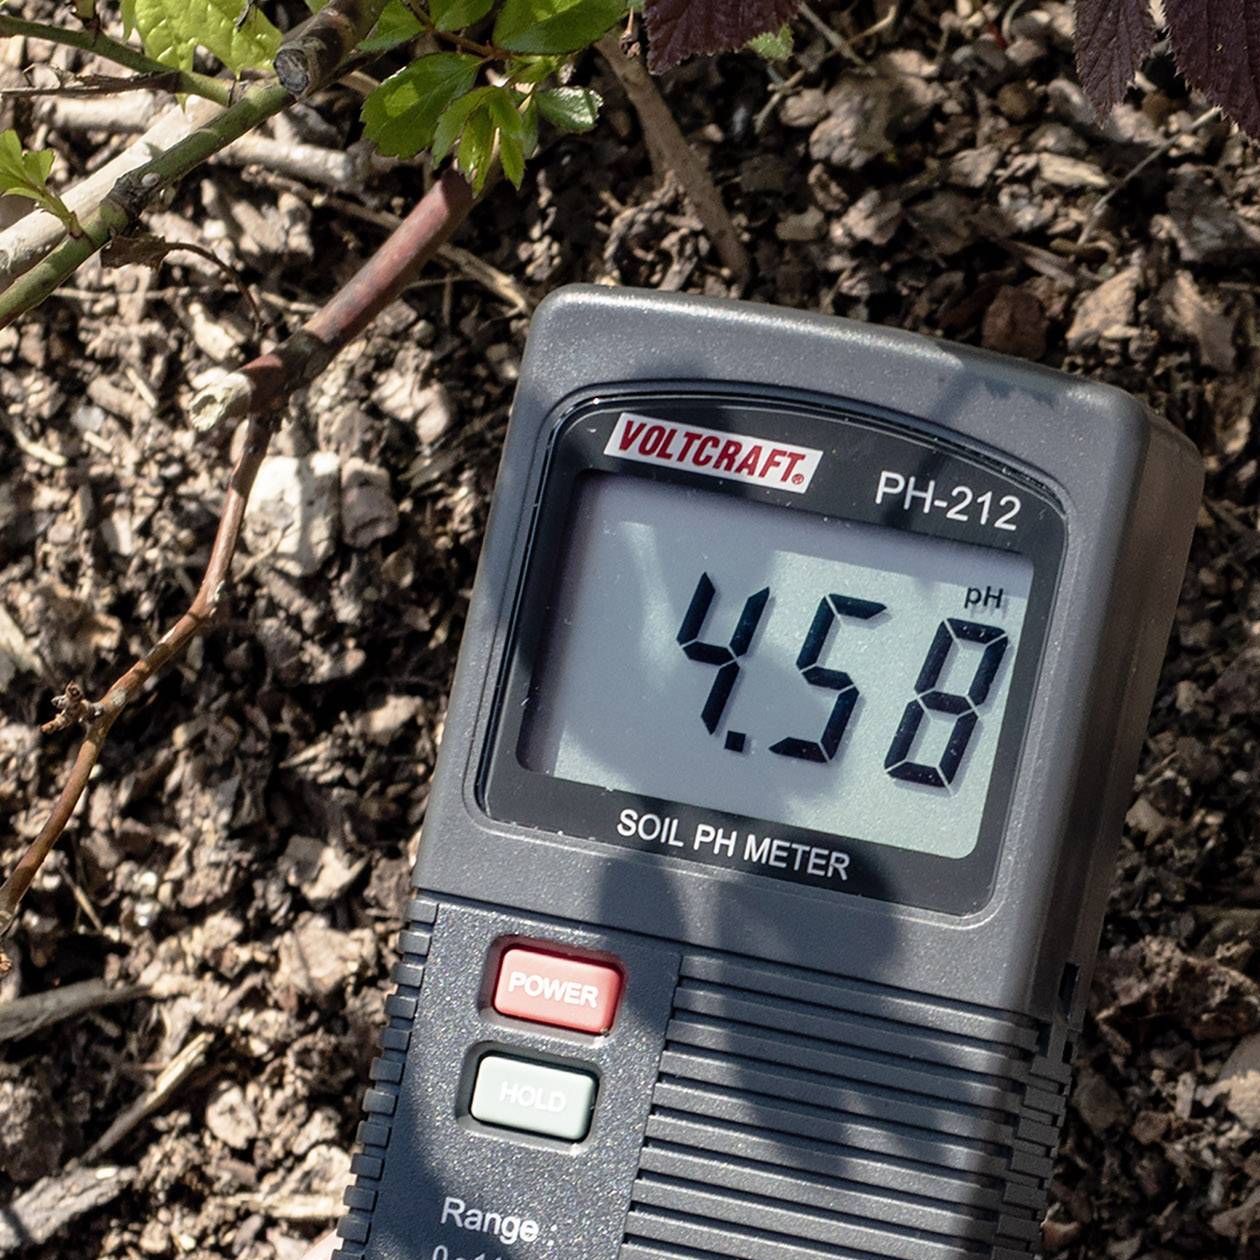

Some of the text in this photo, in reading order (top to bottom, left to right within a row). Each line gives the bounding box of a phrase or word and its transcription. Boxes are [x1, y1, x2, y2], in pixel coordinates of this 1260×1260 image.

[874, 470, 1022, 532] PH-212
[963, 586, 1004, 609] pH
[676, 571, 1009, 790] 4.58
[616, 809, 850, 881] SOIL PH METER
[507, 971, 600, 1009] POWER
[501, 1080, 566, 1114] HOLD
